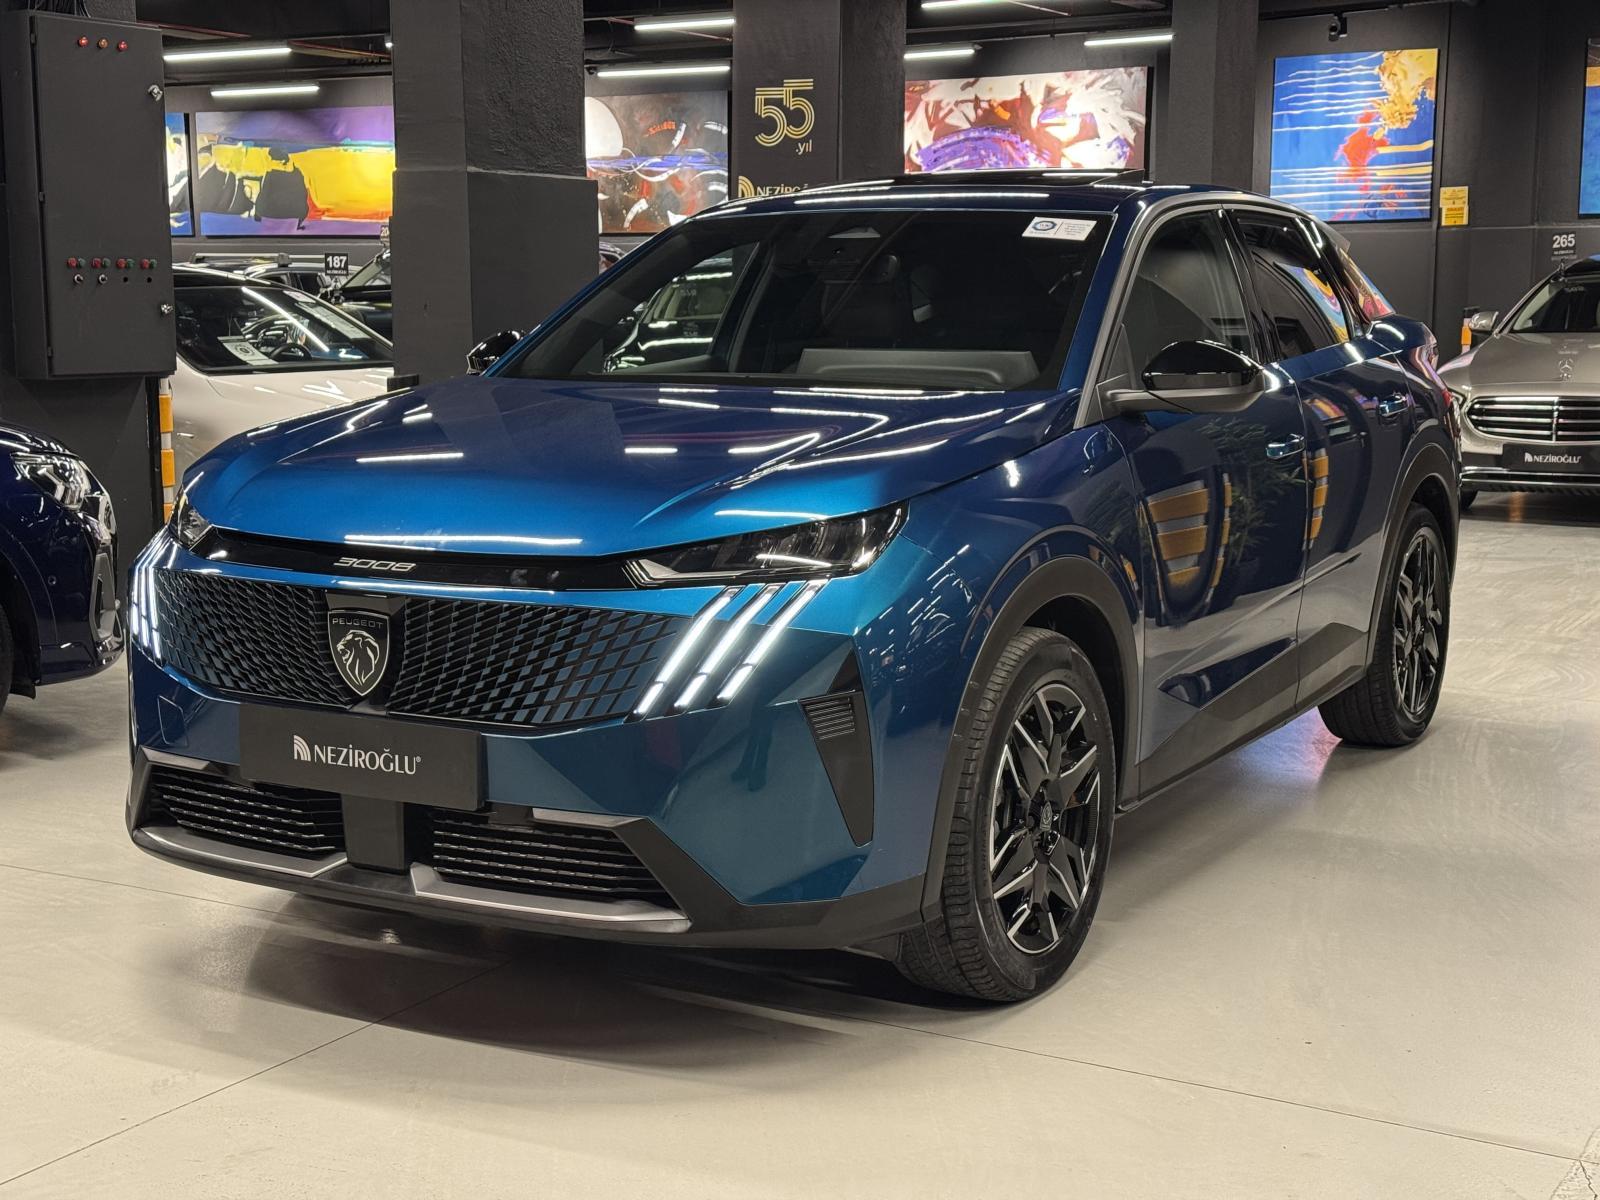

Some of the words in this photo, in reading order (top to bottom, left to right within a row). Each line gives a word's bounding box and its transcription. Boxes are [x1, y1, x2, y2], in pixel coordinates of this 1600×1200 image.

[755, 79, 814, 146] 55
[1553, 234, 1575, 248] 265
[327, 256, 347, 268] 187
[333, 557, 416, 572] 3008
[332, 618, 383, 629] PEUGEOT
